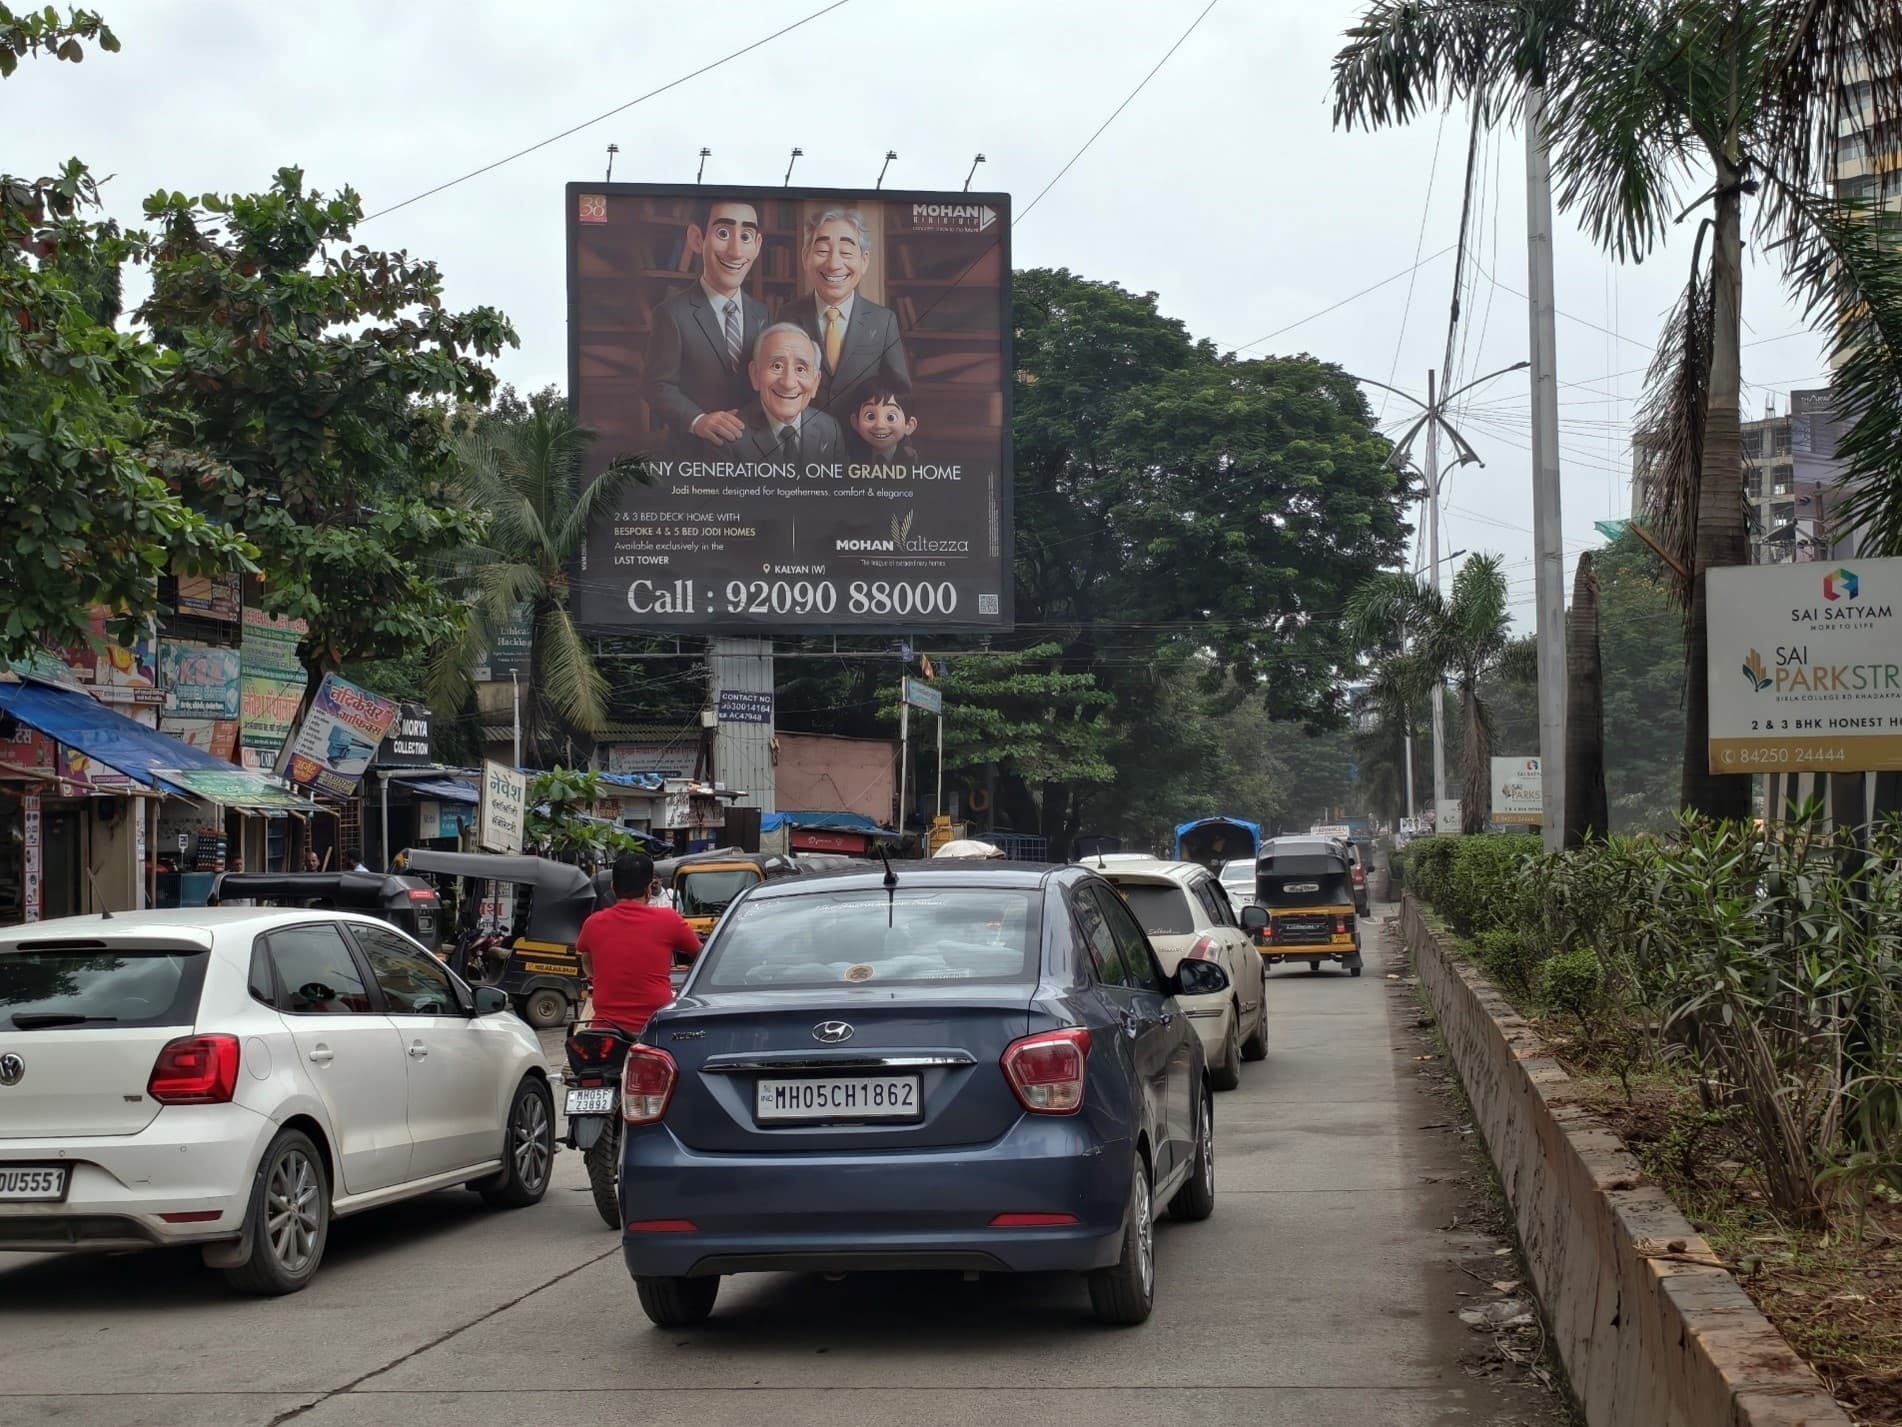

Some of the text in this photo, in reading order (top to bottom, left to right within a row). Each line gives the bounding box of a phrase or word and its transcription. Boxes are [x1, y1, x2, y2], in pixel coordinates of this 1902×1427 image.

[913, 203, 979, 218] MOHAN
[678, 461, 800, 480] GENERATIONS,
[805, 463, 843, 479] ONE
[848, 464, 907, 480] GRAND
[912, 465, 961, 480] HOME
[672, 485, 689, 495] Jodi
[722, 486, 760, 497] designed
[763, 486, 775, 495] for
[833, 486, 865, 496] comfort
[867, 487, 875, 496] &
[877, 488, 914, 499] elegance
[614, 512, 740, 522] 2 & 3 BED DECK HOME WITH
[614, 527, 653, 536] BESPOKE
[656, 527, 661, 536] 4
[674, 528, 680, 536] 5
[682, 528, 699, 536] BED
[701, 528, 720, 537] JODI
[723, 528, 756, 537] HOMES
[615, 541, 724, 552] Available exclusively in the
[836, 535, 969, 552] MOHAN altezza
[614, 556, 670, 565] LAST TOWER
[775, 564, 826, 575] KALYAN (W)
[627, 579, 695, 613] Call
[726, 580, 837, 614] 92090
[848, 581, 957, 614] 88000
[1791, 605, 1892, 622] SAI SATYAM
[1776, 646, 1807, 666] SAI
[722, 693, 758, 702] CONTACT
[402, 719, 428, 737] MORYA
[1751, 720, 1759, 730] 2
[1765, 720, 1774, 730] &
[1781, 720, 1788, 729] 3
[1796, 718, 1822, 729] BHK
[1829, 717, 1883, 729] HONEST
[393, 741, 429, 755] COLLECTION
[1740, 748, 1846, 763] 84250 24444
[775, 1083, 913, 1109] MH05CH1862
